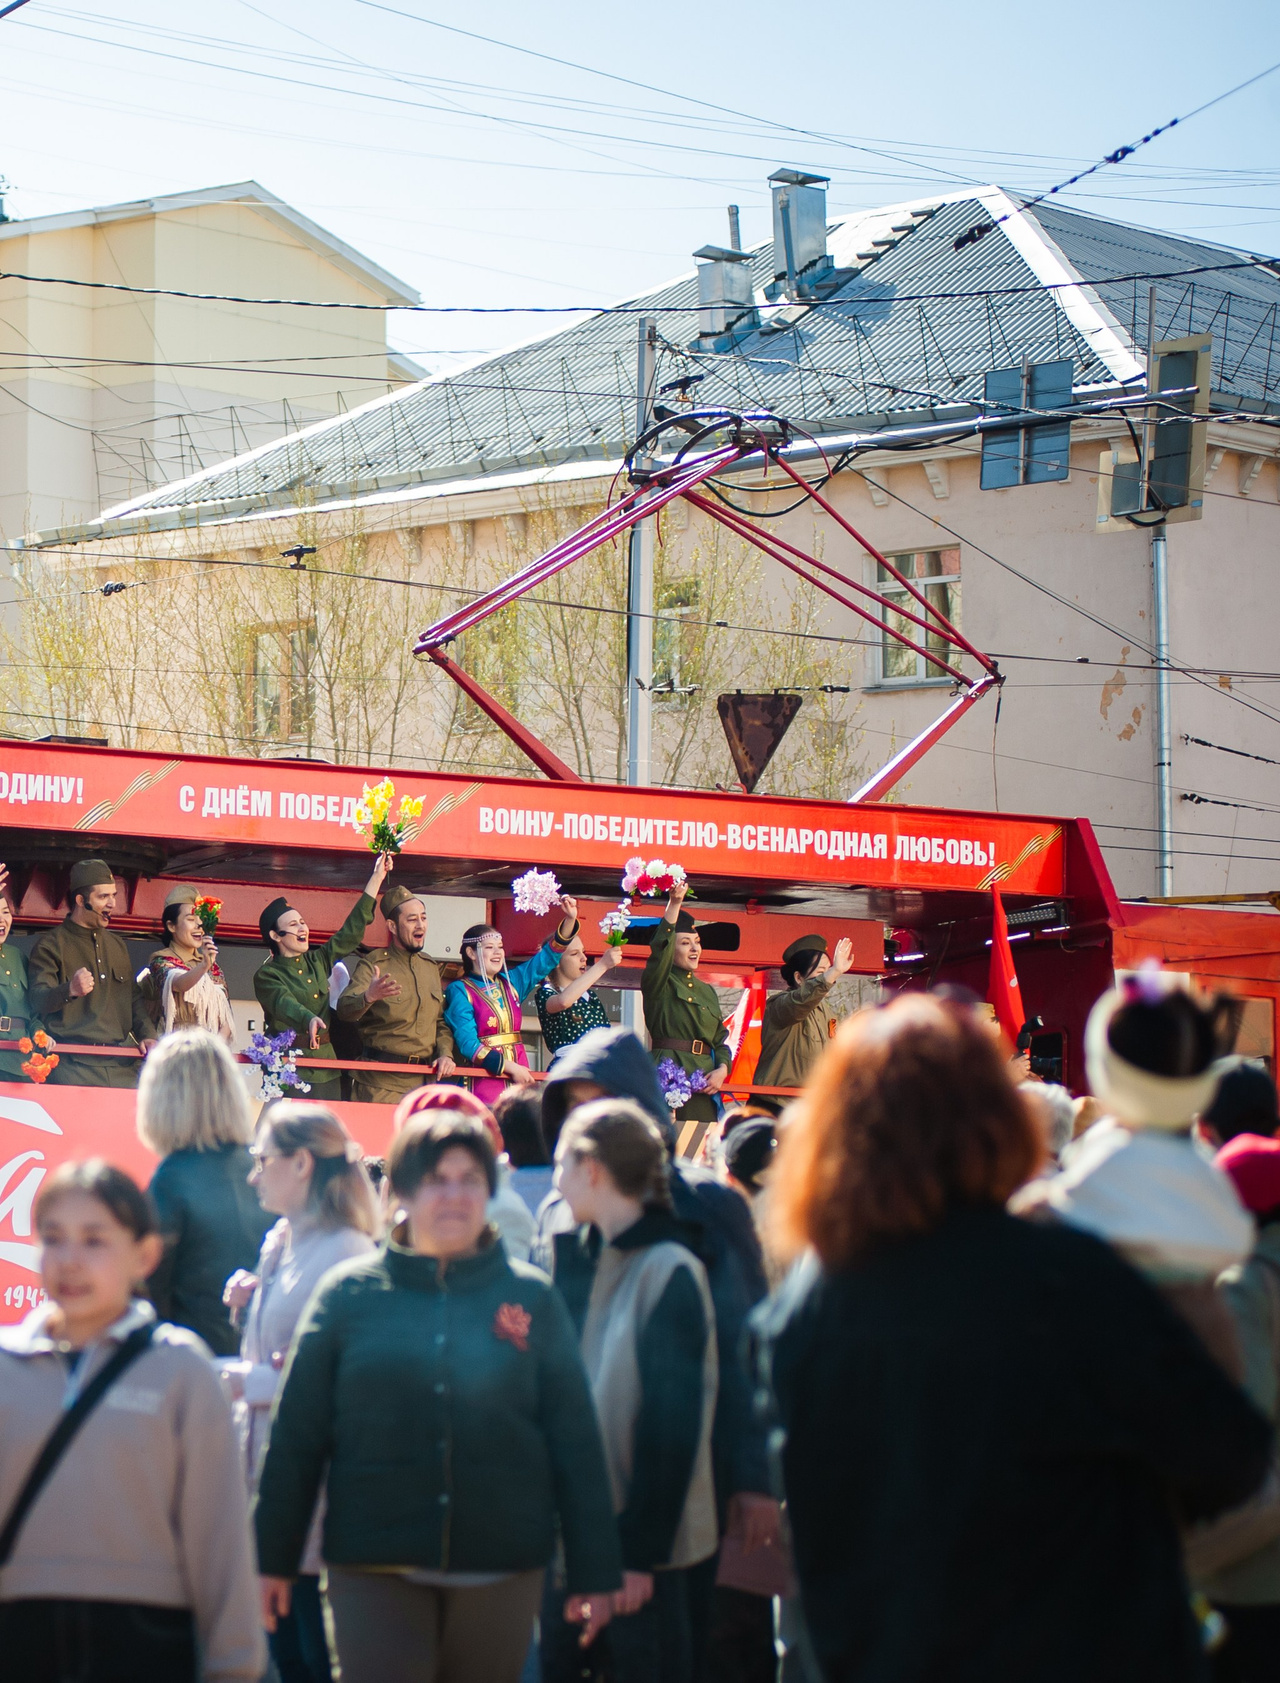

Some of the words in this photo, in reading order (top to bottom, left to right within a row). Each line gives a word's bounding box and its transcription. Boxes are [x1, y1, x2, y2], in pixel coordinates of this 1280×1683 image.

[178, 785, 195, 815] С
[201, 784, 273, 820] ДНЁМ
[278, 789, 373, 829] ПОБЕД
[478, 806, 888, 861] ВОИНУ-ПОБЕДИТЕЛЮ-ВСЕНАРОДНАЯ
[893, 834, 996, 868] ЛЮБОВЬ!
